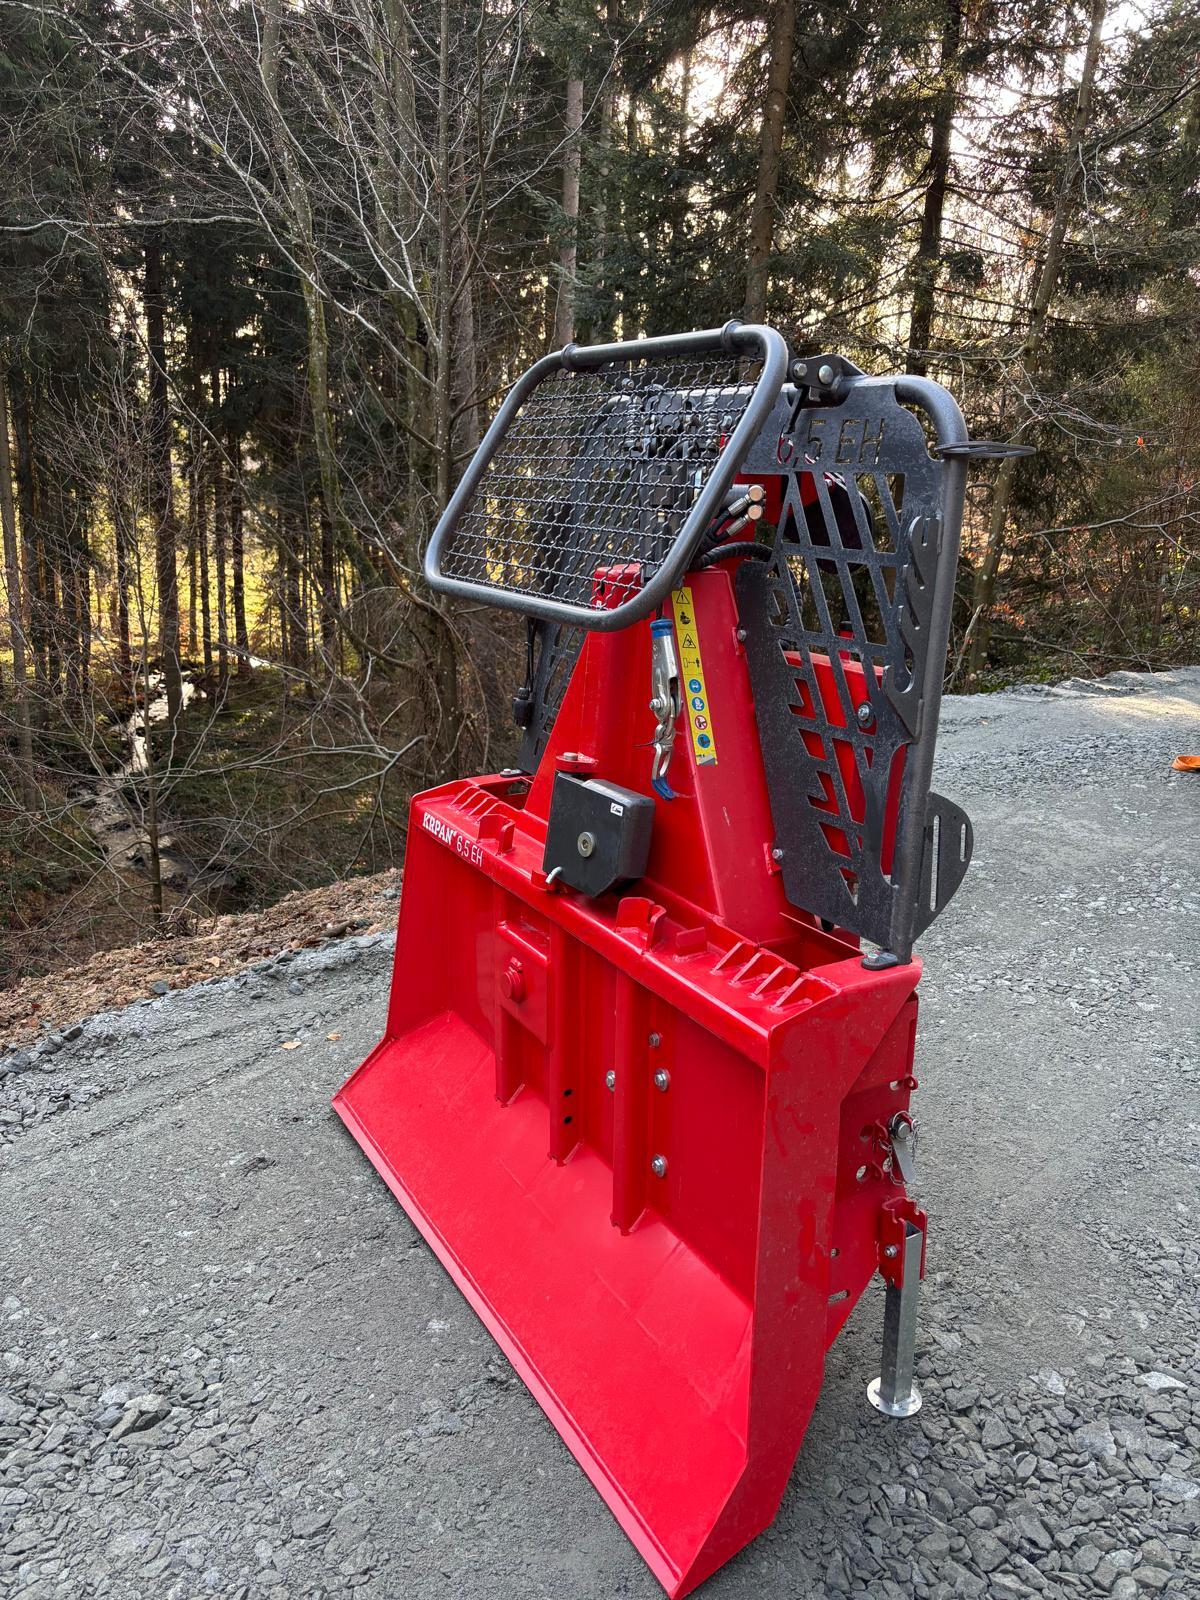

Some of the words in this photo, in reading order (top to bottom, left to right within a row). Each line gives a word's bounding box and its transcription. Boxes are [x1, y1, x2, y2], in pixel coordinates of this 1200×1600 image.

[835, 418, 885, 465] EH
[456, 836, 470, 857] 6,5
[471, 845, 483, 867] EH
